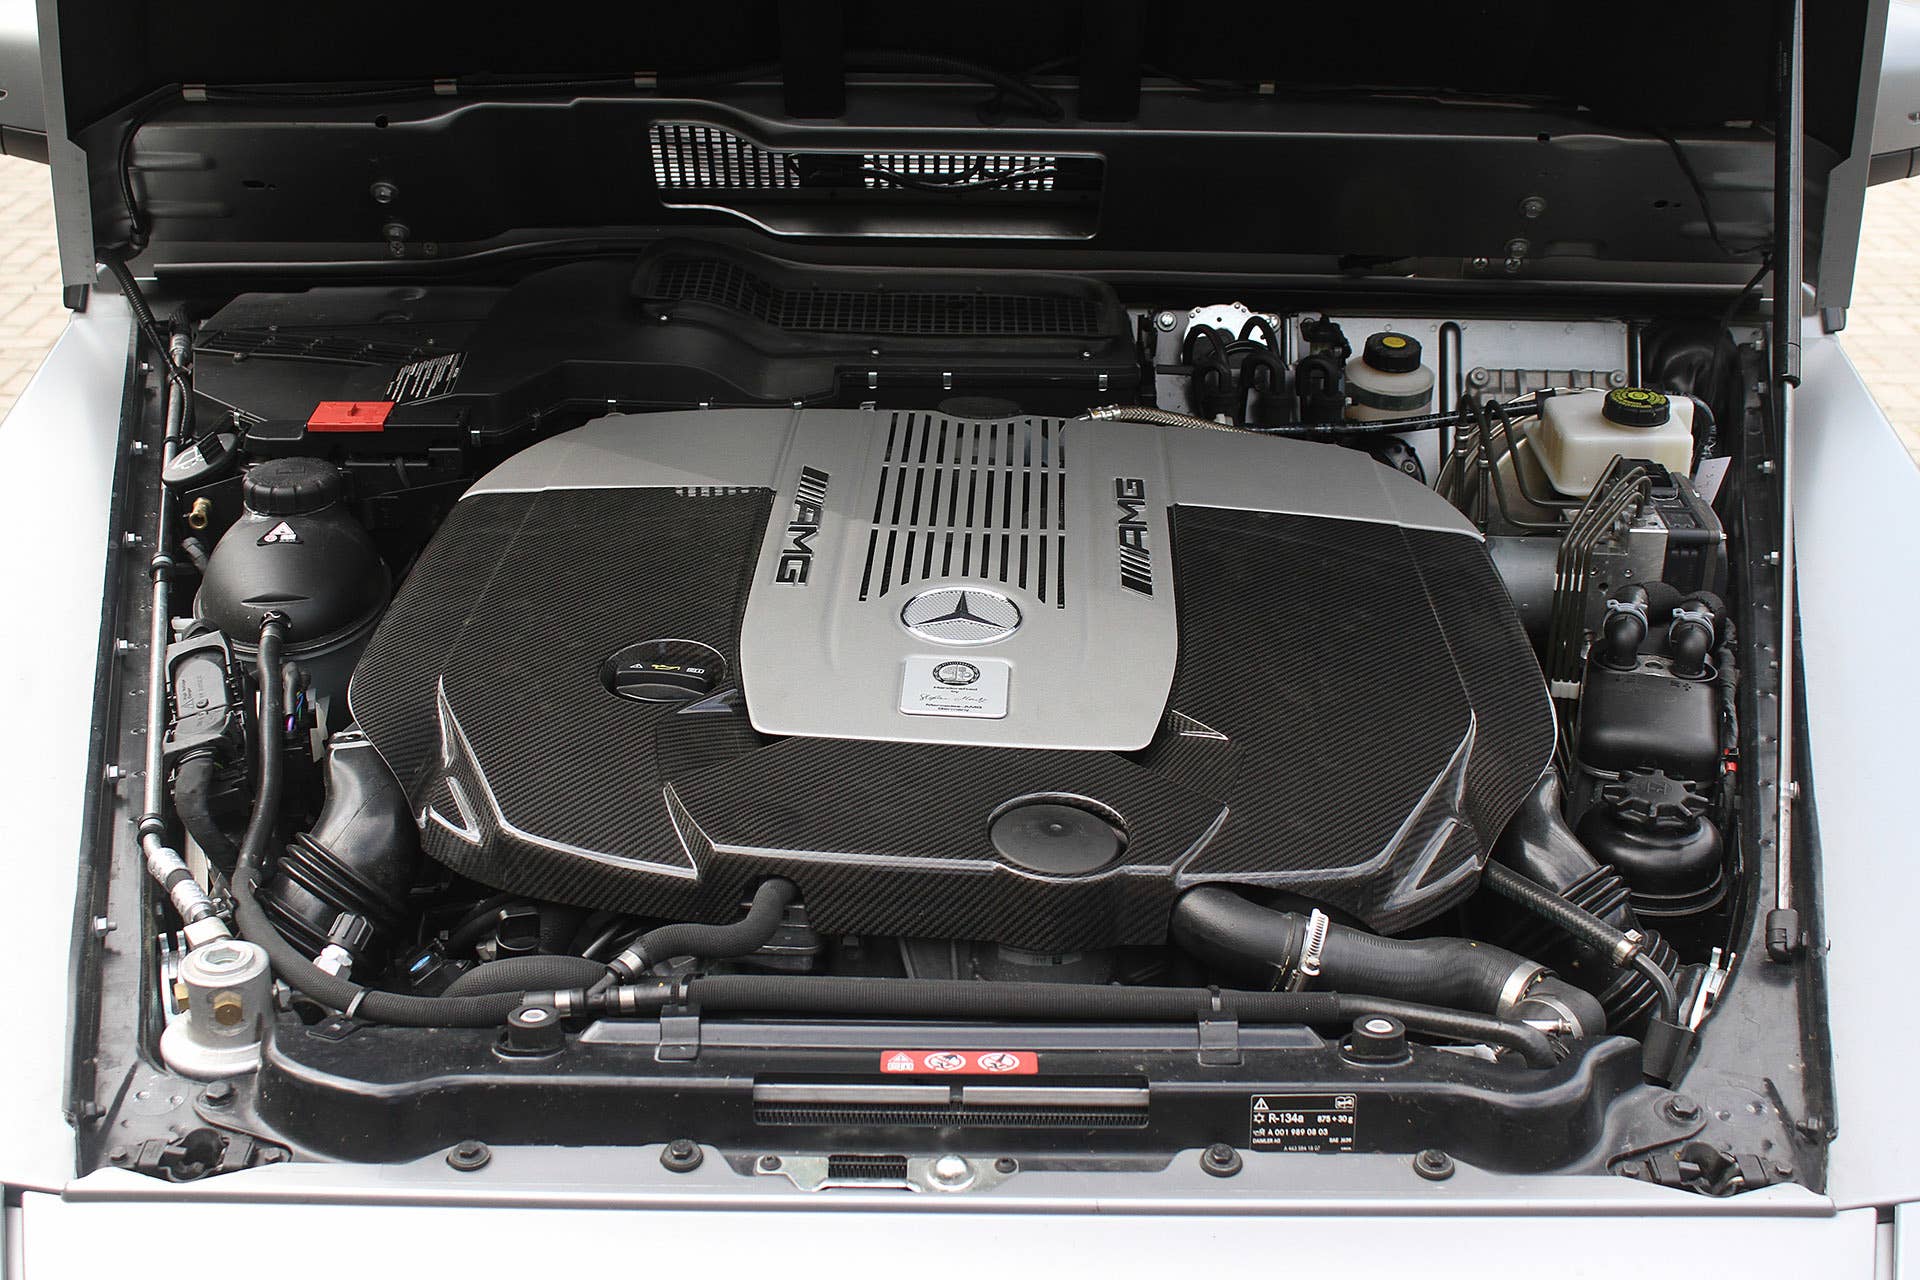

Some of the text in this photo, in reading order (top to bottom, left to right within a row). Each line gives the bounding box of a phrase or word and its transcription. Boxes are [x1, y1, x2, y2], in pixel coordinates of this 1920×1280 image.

[1268, 1113, 1304, 1124] R-134a
[1274, 1128, 1289, 1136] 001
[1291, 1128, 1305, 1136] 989
[1318, 1128, 1329, 1136] 03
